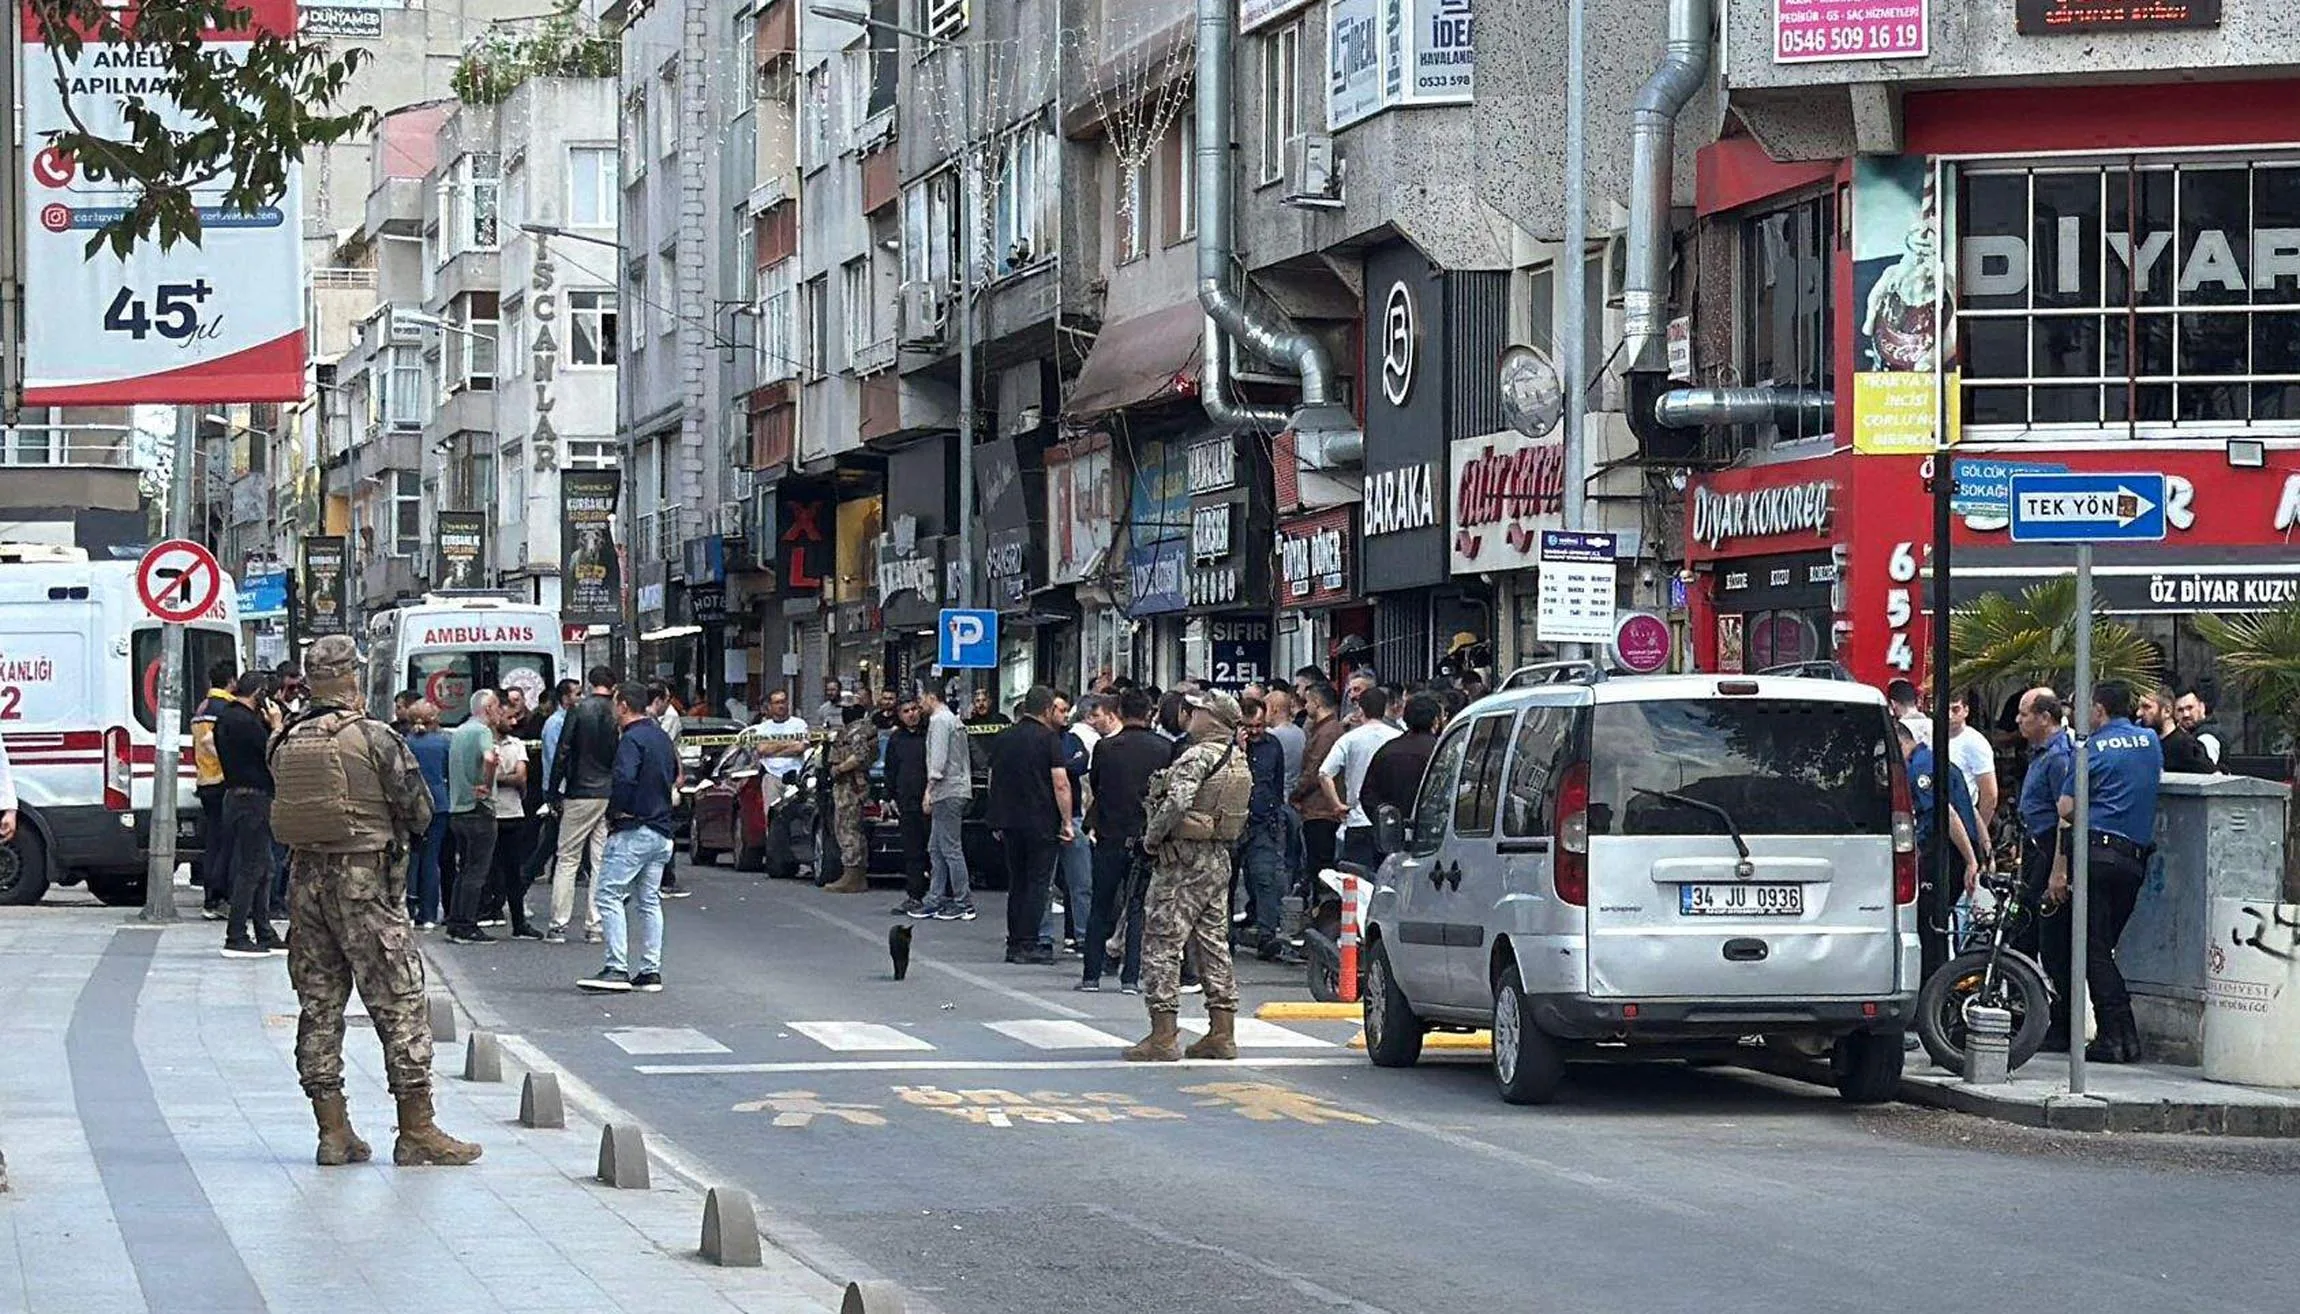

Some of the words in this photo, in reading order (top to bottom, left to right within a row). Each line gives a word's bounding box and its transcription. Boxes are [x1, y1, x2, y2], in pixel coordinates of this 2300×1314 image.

[1782, 28, 1826, 52] 0546
[1830, 26, 1864, 50] 509
[1869, 25, 1890, 48] 16
[1896, 24, 1917, 47] 19
[1419, 77, 1447, 87] 0533
[1450, 75, 1470, 86] 598
[1961, 464, 2006, 478] GÖLCÜK
[1364, 463, 1433, 536] BARAKA
[1960, 484, 2008, 498] SOKAĞI
[2028, 499, 2065, 515] TEK
[2074, 495, 2114, 515] YÖN
[2150, 575, 2176, 602] ÖZ
[2181, 573, 2239, 602] DİYAR
[424, 626, 534, 644] AMBULANS
[950, 615, 983, 661] P
[1213, 622, 1267, 640] SIFIR
[1235, 645, 1245, 656] &
[1215, 662, 1265, 682] 2.EL
[1693, 886, 1713, 907] 34
[1726, 886, 1746, 907] JU
[1757, 886, 1799, 907] 0936
